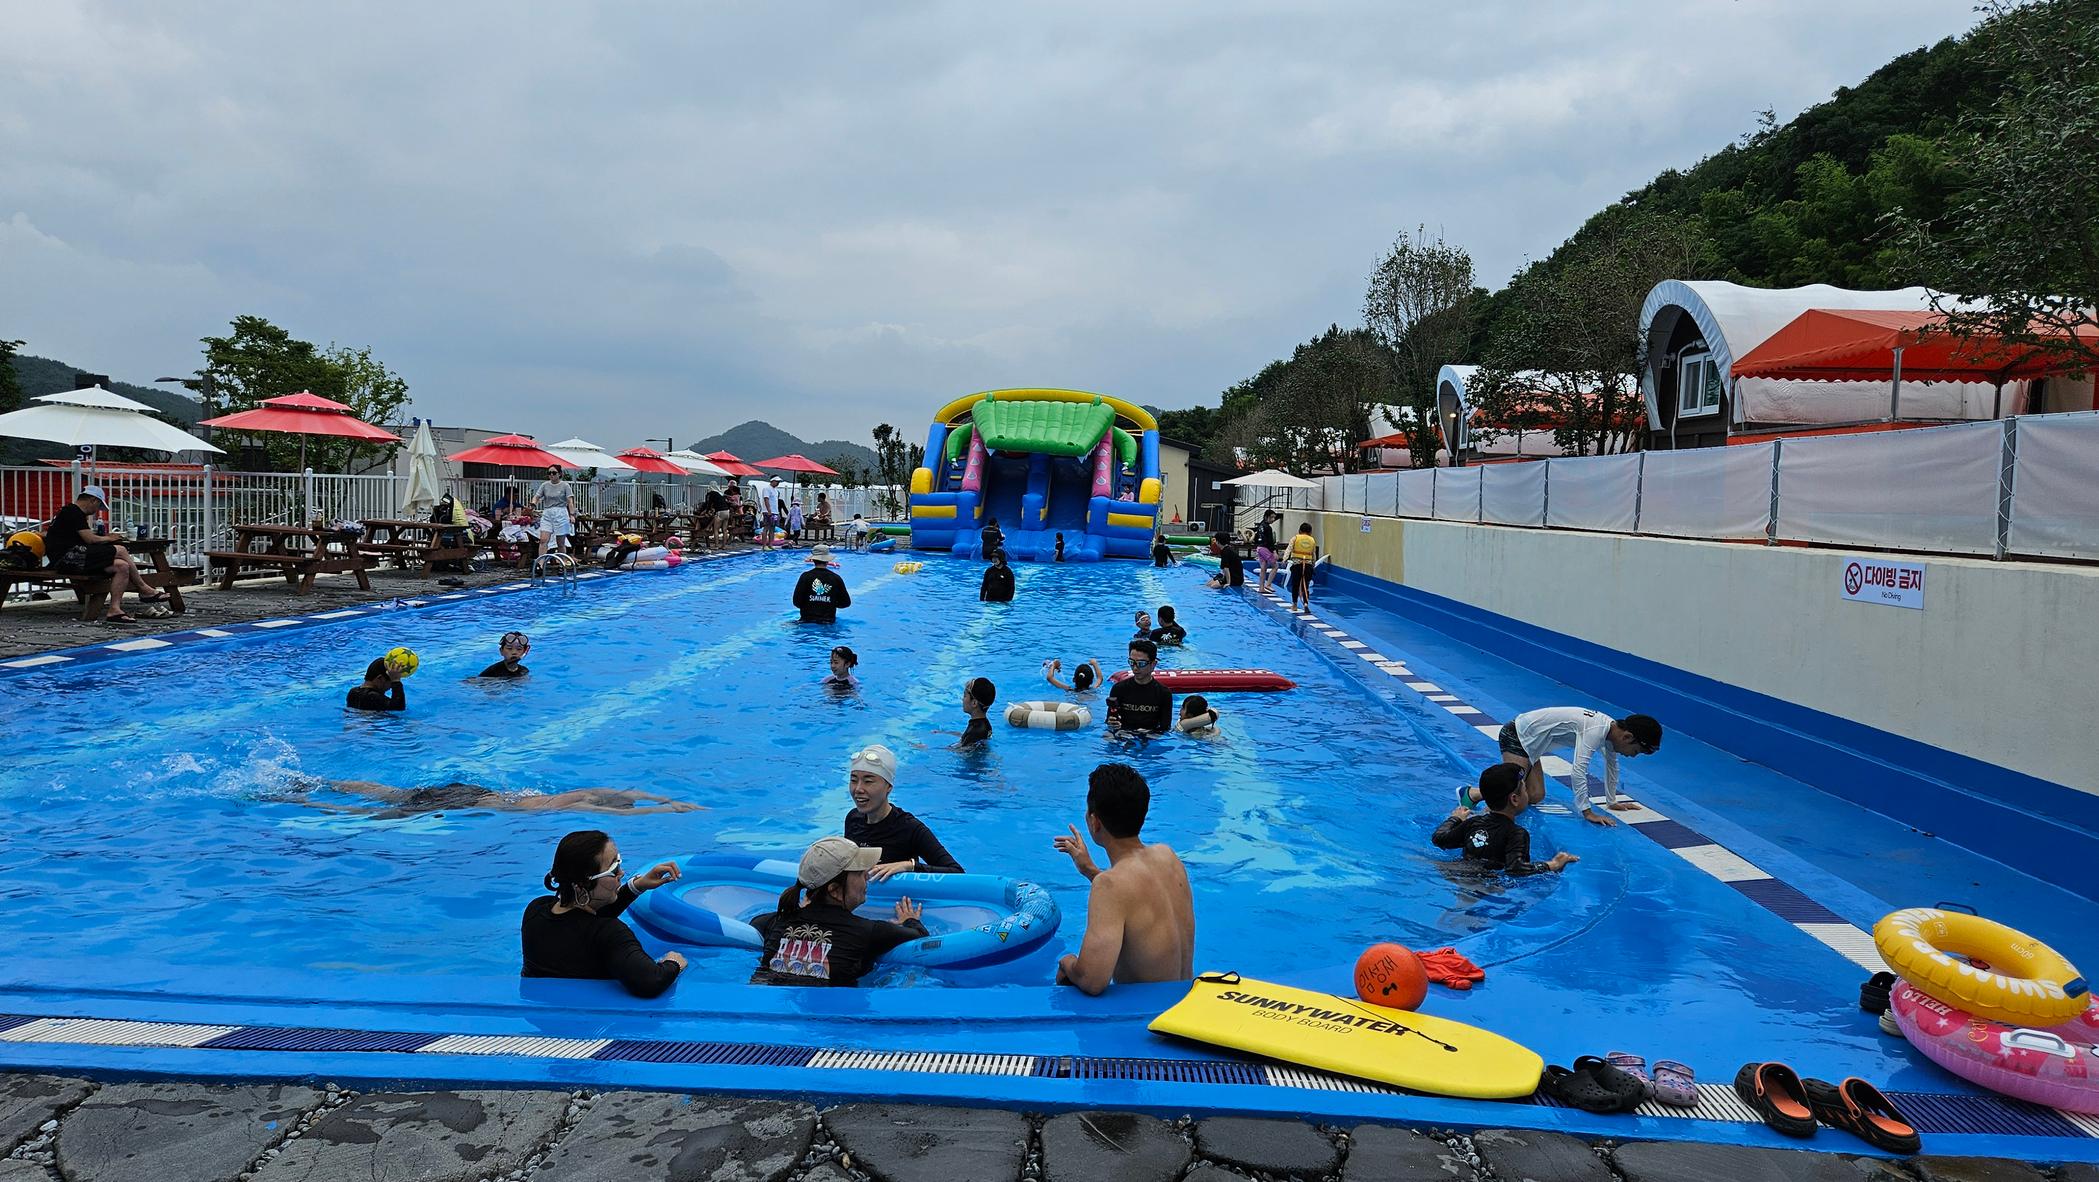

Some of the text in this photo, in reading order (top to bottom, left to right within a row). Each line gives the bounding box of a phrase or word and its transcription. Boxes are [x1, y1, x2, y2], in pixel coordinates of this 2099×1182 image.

[1864, 565, 1922, 591] 다이빙 금지
[1881, 591, 1902, 601] No Diving
[776, 937, 833, 965] ROXY
[1358, 954, 1399, 994] 김성재
[1216, 991, 1411, 1037] SUNNYWATER
[1901, 988, 1954, 1016] HELLO
[1251, 1008, 1354, 1035] BODY BOARD
